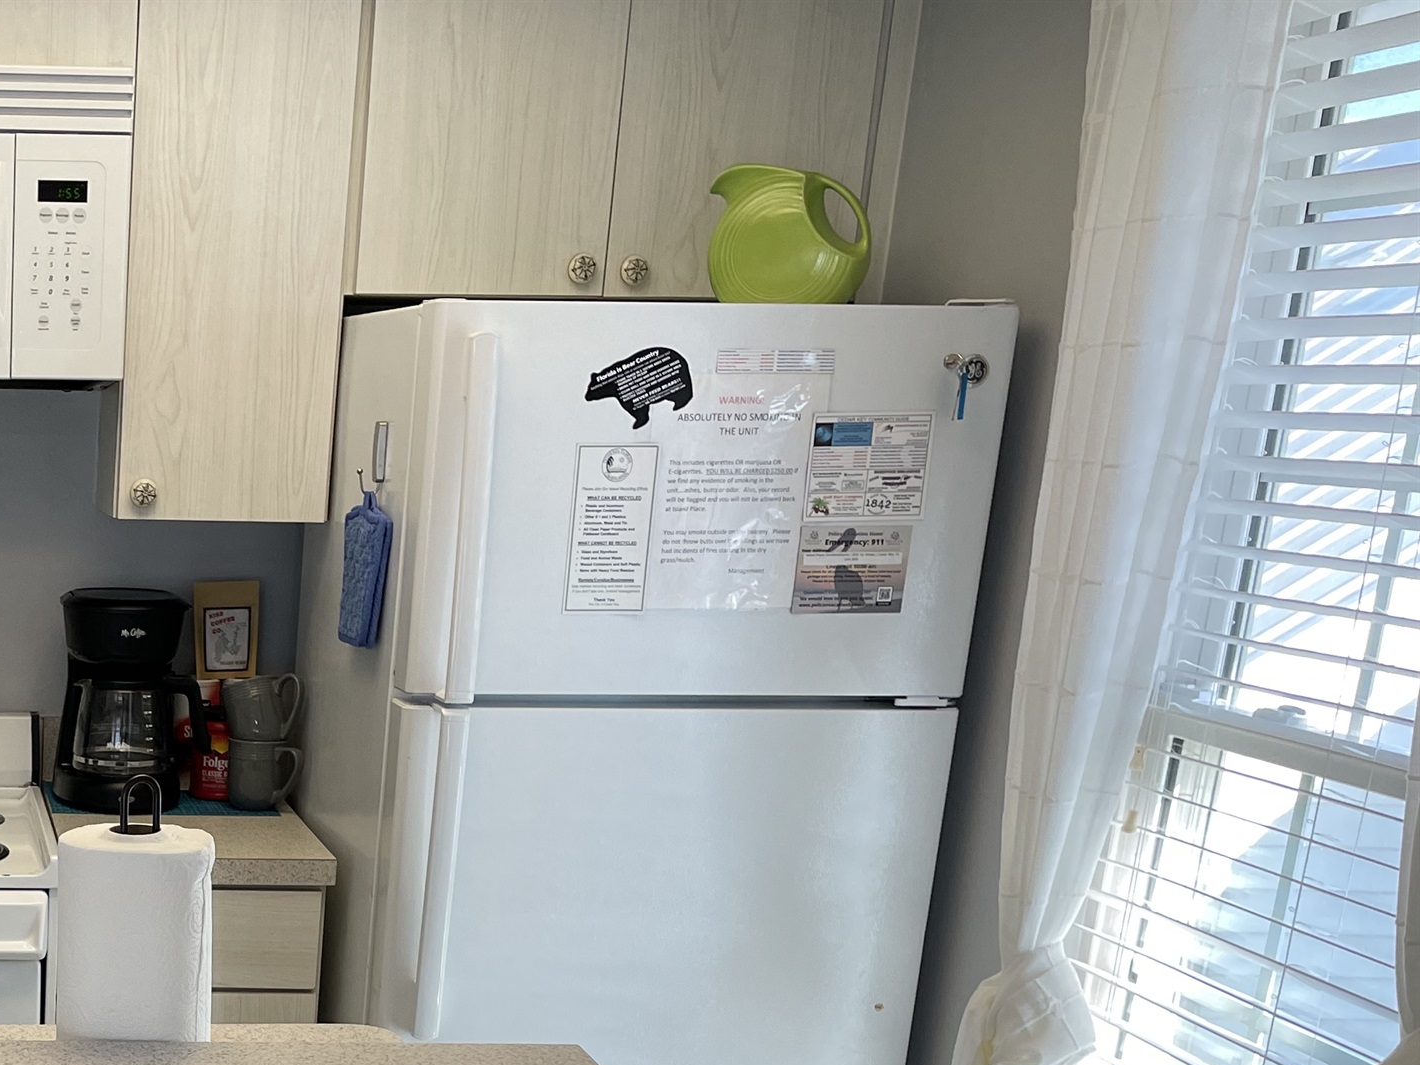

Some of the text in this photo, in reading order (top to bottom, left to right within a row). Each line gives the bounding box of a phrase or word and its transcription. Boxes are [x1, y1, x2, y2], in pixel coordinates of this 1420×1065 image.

[58, 188, 80, 199] 1:55
[596, 368, 617, 383] Florida
[621, 361, 635, 370] Bear
[635, 350, 659, 364] Country
[677, 413, 732, 422] ABSOLUTELY
[734, 413, 747, 421] NO
[719, 427, 759, 436] THE UNIT
[866, 499, 892, 510] 1842
